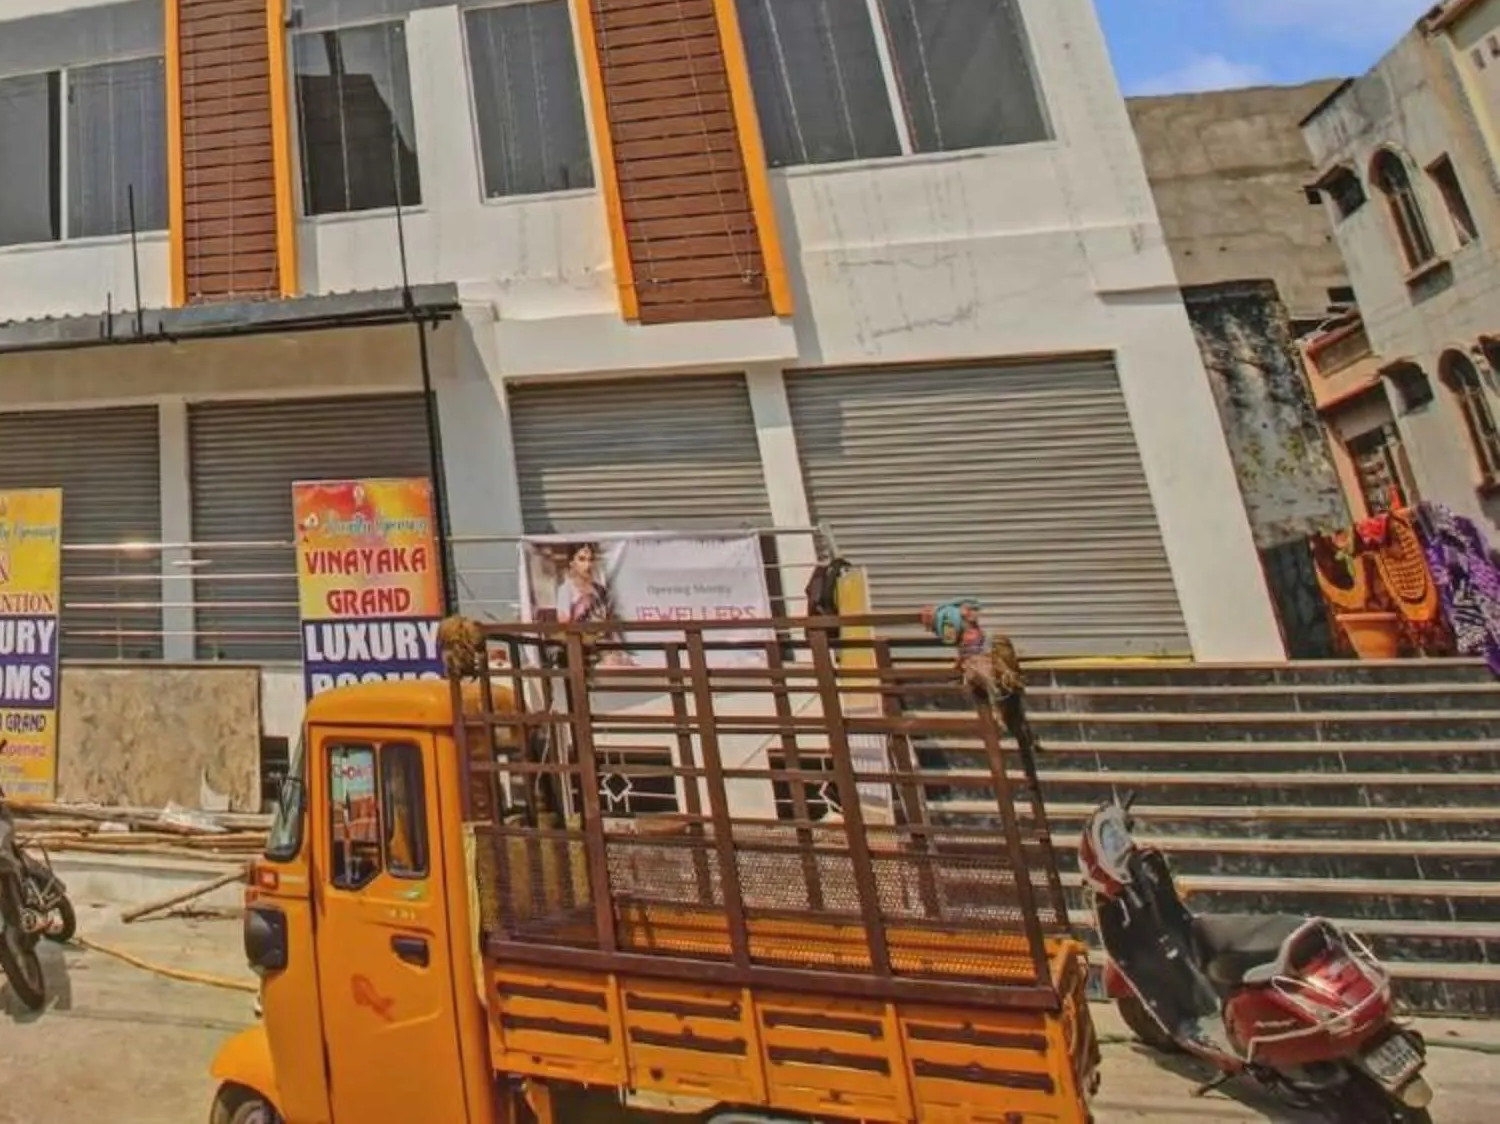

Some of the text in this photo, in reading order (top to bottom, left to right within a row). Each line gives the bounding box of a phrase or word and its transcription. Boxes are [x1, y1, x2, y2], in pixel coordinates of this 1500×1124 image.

[305, 547, 428, 575] VINAYAKA
[326, 587, 411, 615] GRAND
[304, 622, 439, 661] LUXURY
[6, 713, 47, 733] GRAND
